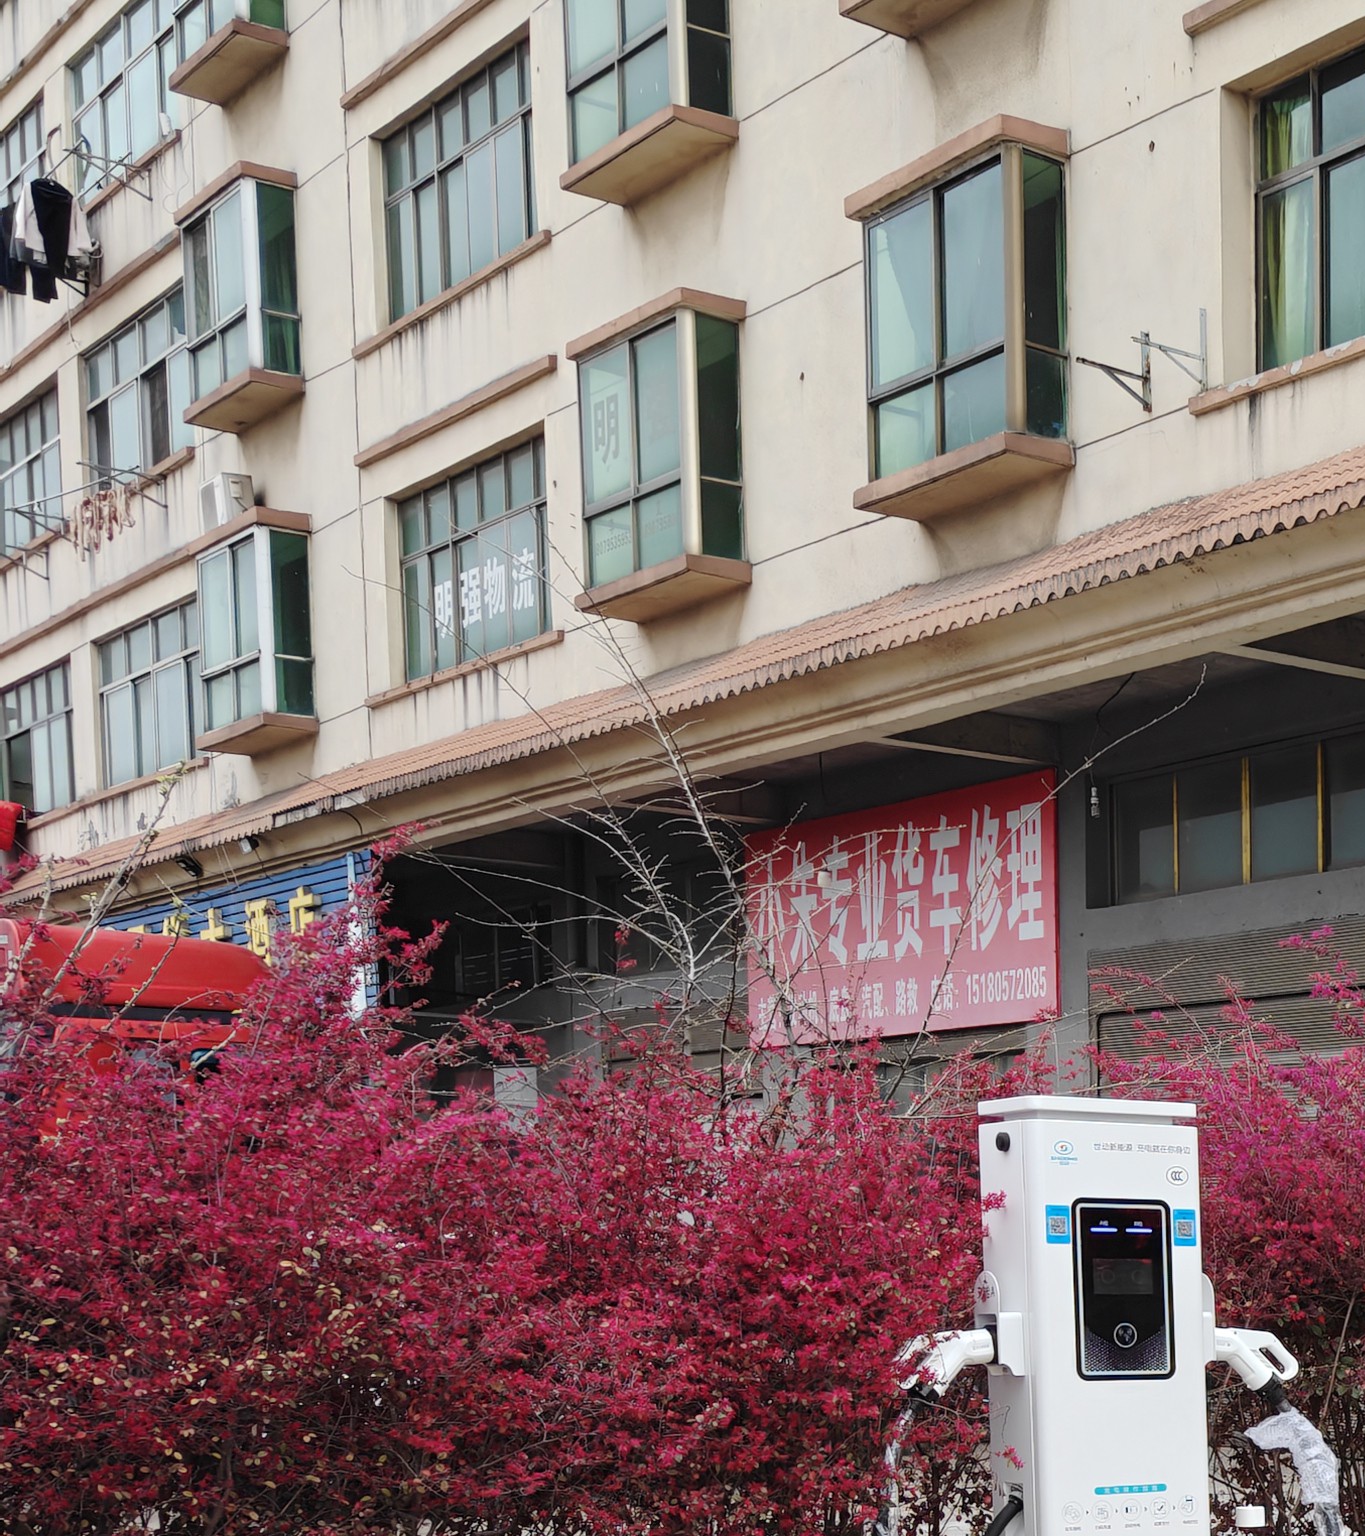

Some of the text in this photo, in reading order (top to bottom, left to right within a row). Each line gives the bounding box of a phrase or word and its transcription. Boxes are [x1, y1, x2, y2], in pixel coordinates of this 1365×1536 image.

[434, 547, 535, 639] 明强物流
[757, 801, 1045, 973] 小朱专业货车修理
